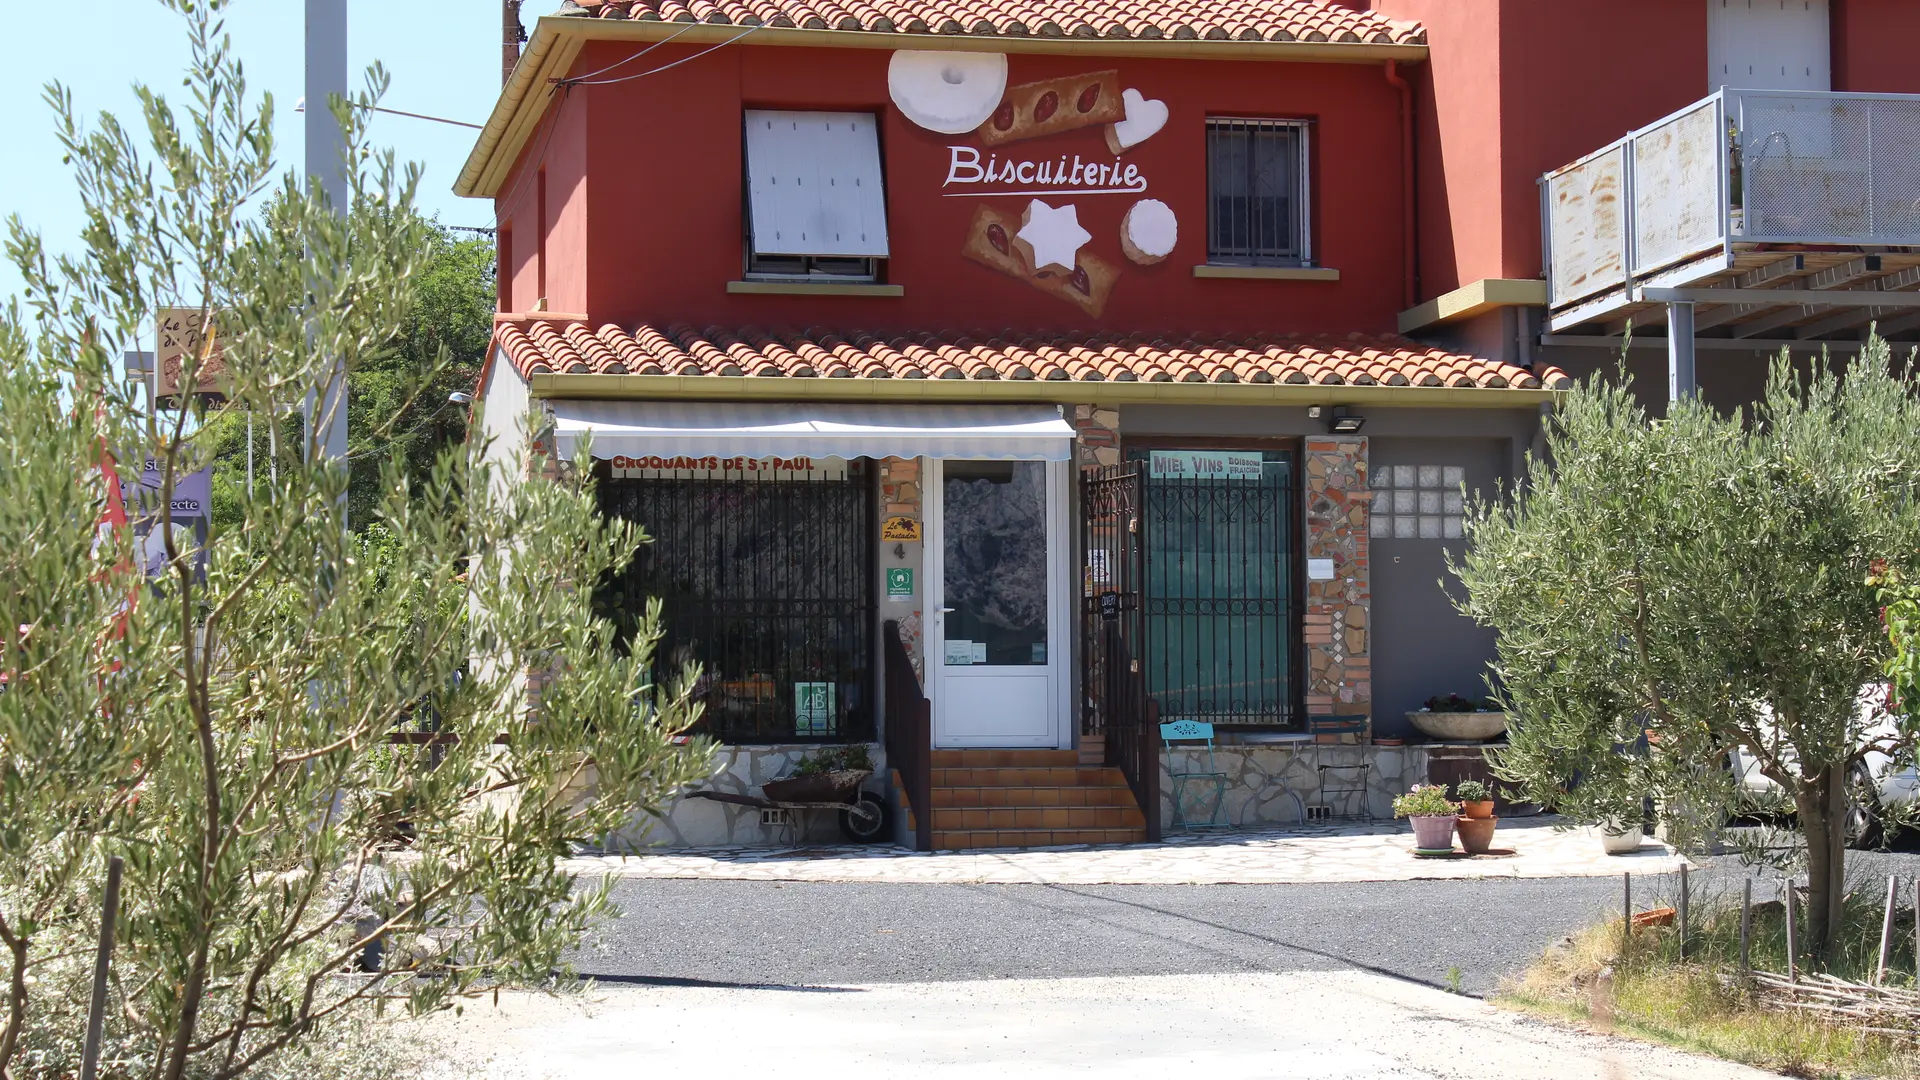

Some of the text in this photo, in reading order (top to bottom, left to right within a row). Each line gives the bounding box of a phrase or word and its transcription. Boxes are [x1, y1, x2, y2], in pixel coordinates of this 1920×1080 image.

[942, 146, 1147, 193] Biscuiterie
[161, 317, 180, 333] Le
[612, 456, 718, 469] CROQUANTS
[722, 458, 743, 471] DE
[772, 457, 815, 471] PAUL
[1153, 456, 1223, 473] MIEL VINS
[1228, 456, 1260, 467] BOISSONS
[887, 521, 897, 530] Le
